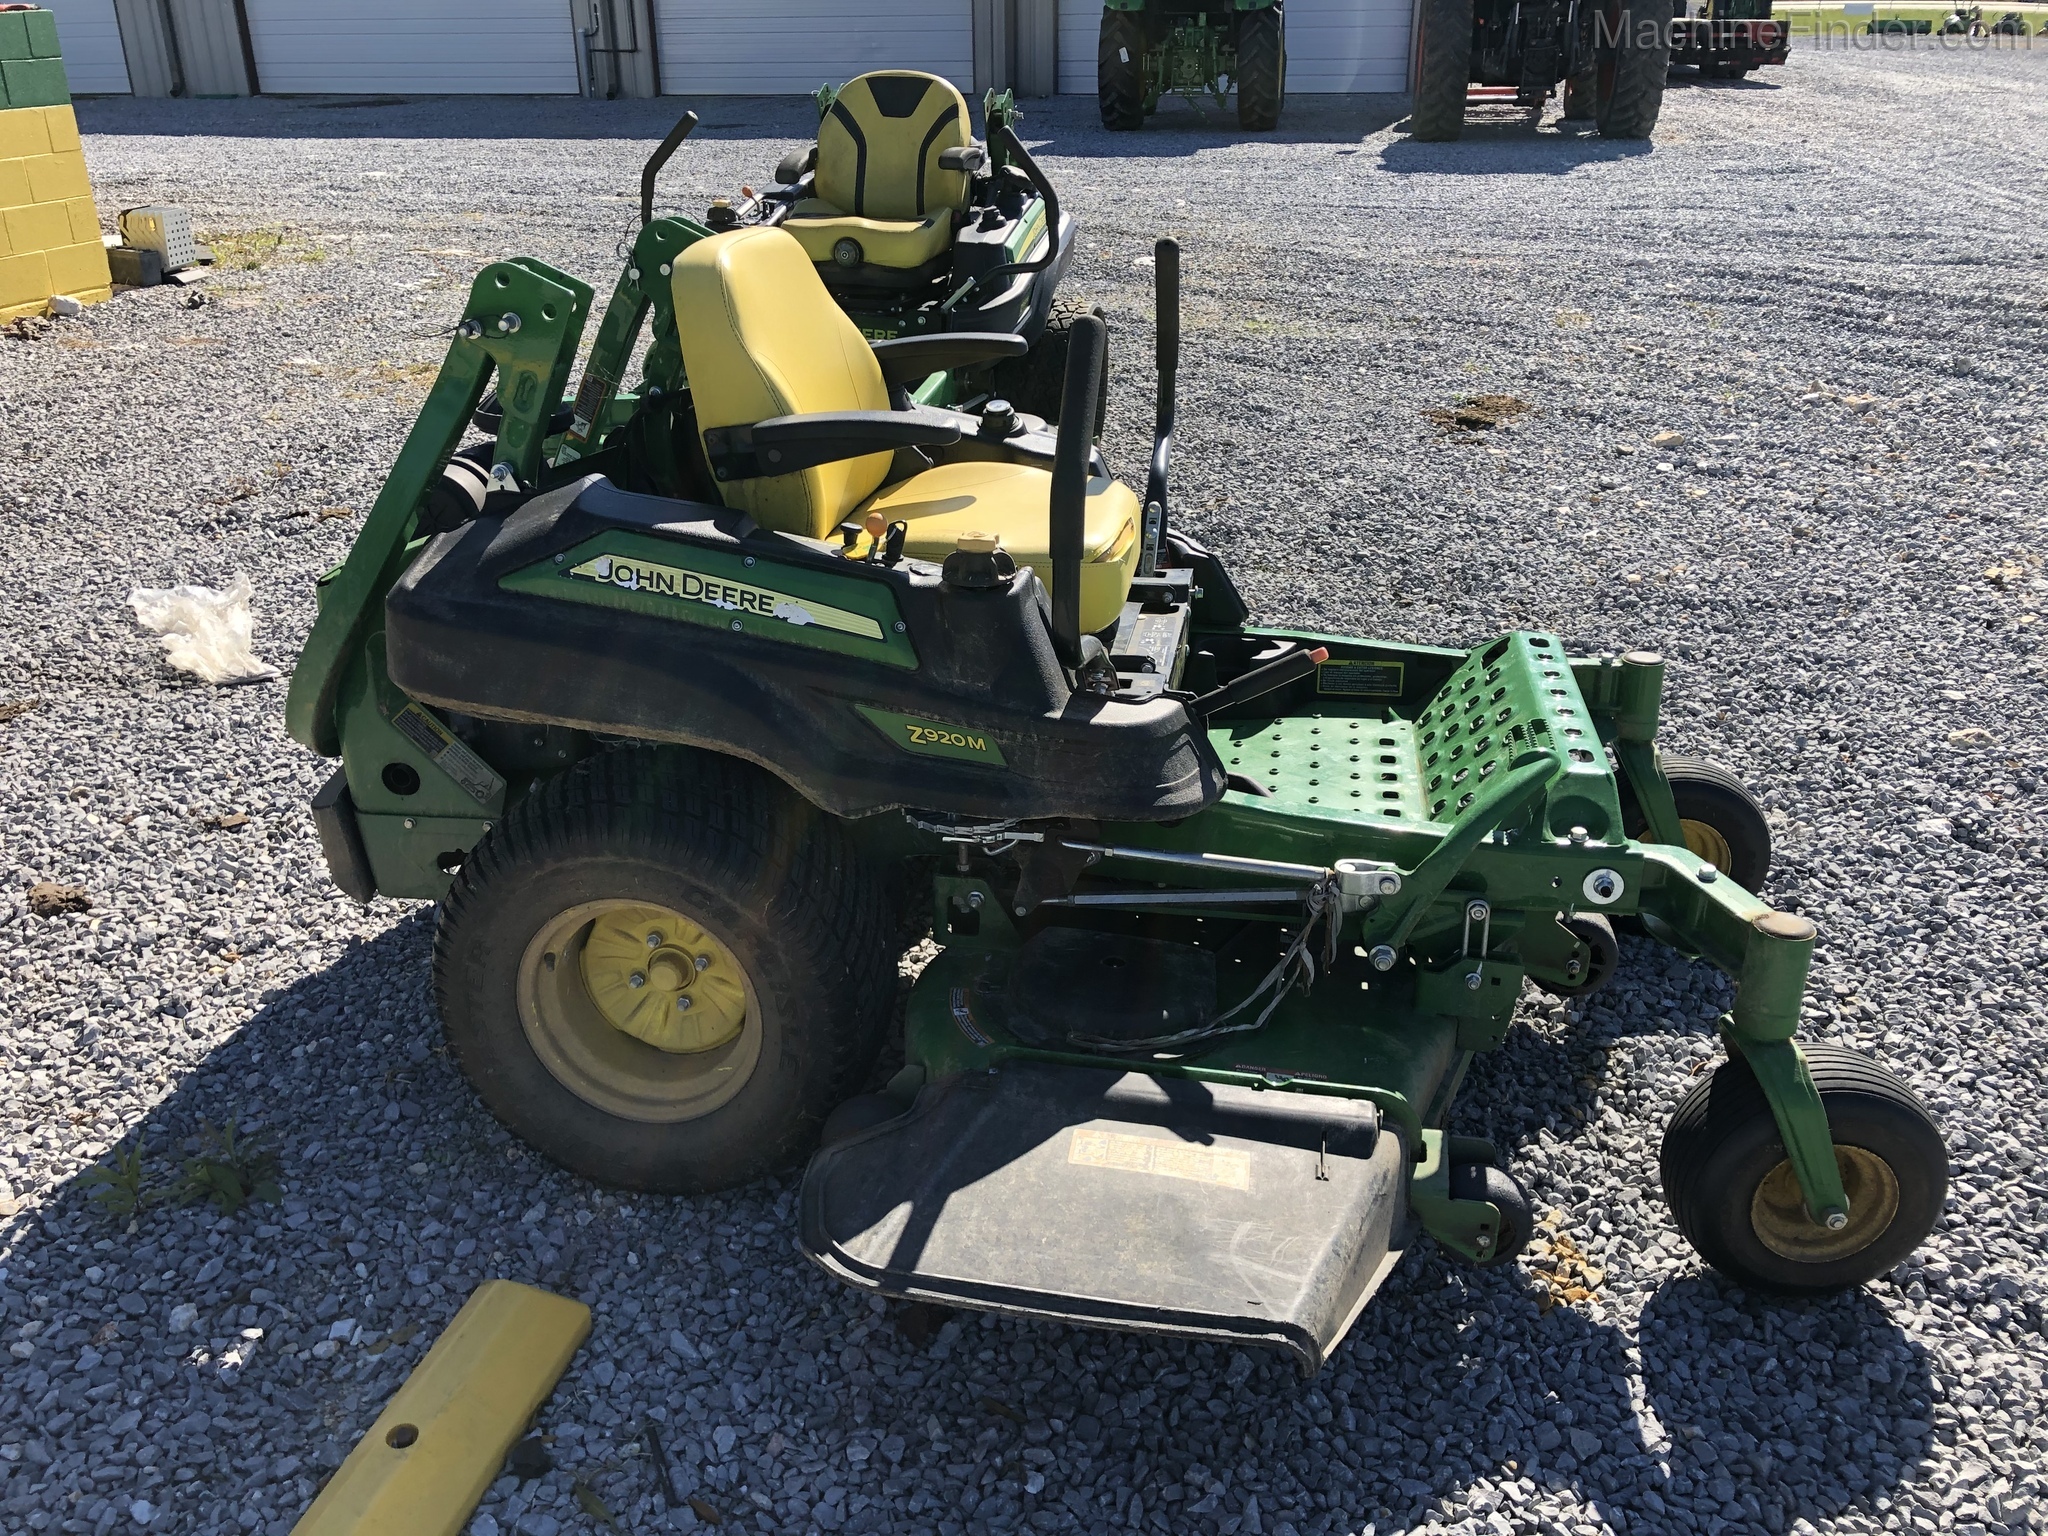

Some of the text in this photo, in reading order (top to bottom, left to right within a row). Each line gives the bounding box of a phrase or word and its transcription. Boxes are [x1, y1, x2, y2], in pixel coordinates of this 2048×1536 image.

[598, 558, 775, 614] JOHN DEERE
[905, 724, 987, 751] Z920M
